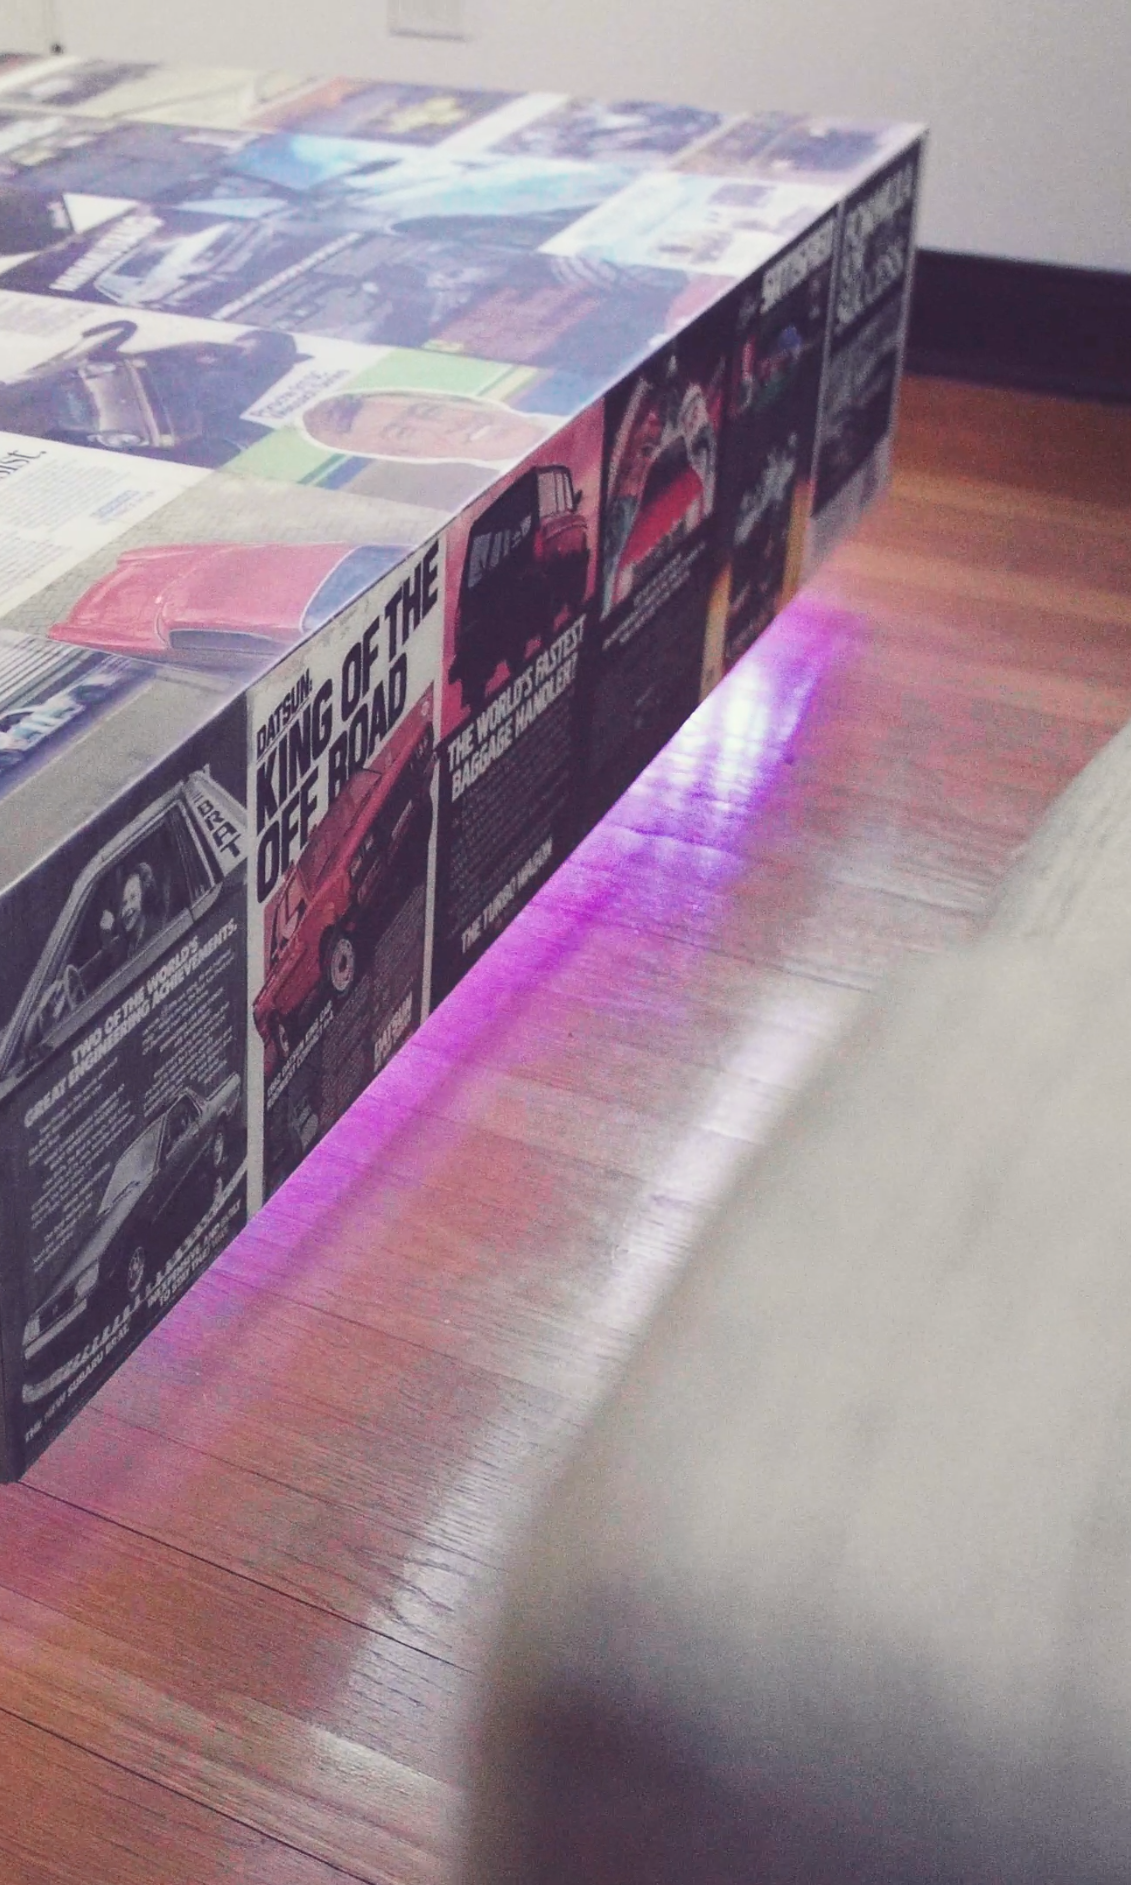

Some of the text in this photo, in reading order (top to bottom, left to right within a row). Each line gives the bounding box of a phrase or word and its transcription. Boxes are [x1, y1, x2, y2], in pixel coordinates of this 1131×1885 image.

[255, 539, 438, 838] KING OF THE
[256, 664, 312, 761] DATSUN:
[447, 614, 586, 774] THE WORLD'S FASTEST
[452, 715, 513, 803] BAGGAGE
[515, 649, 578, 739] HANDLER?
[198, 800, 240, 857] BRAT
[256, 765, 318, 908] OFF
[328, 649, 407, 808] ROAD
[24, 1075, 66, 1131] GREAT
[68, 996, 149, 1088] ENGINEERING
[71, 933, 198, 1068] TWO OF THE WORLD'S
[67, 1350, 103, 1397] SUBARU
